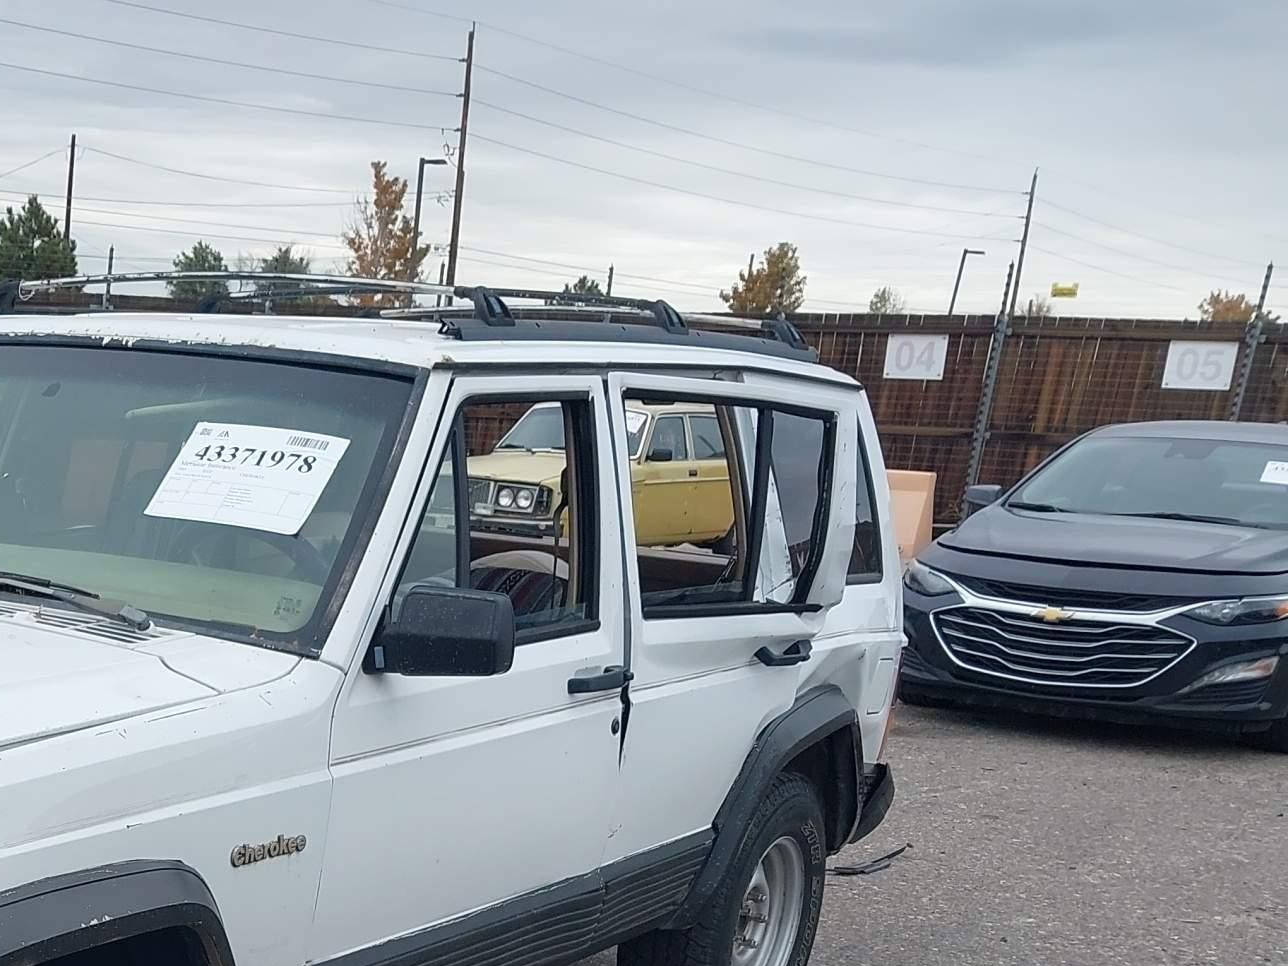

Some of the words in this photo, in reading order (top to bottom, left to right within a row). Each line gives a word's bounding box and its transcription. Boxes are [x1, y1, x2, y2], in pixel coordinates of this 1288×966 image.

[895, 340, 937, 373] 04
[1175, 347, 1225, 382] 05
[195, 444, 317, 475] 43371978
[230, 833, 307, 868] Cherokee
